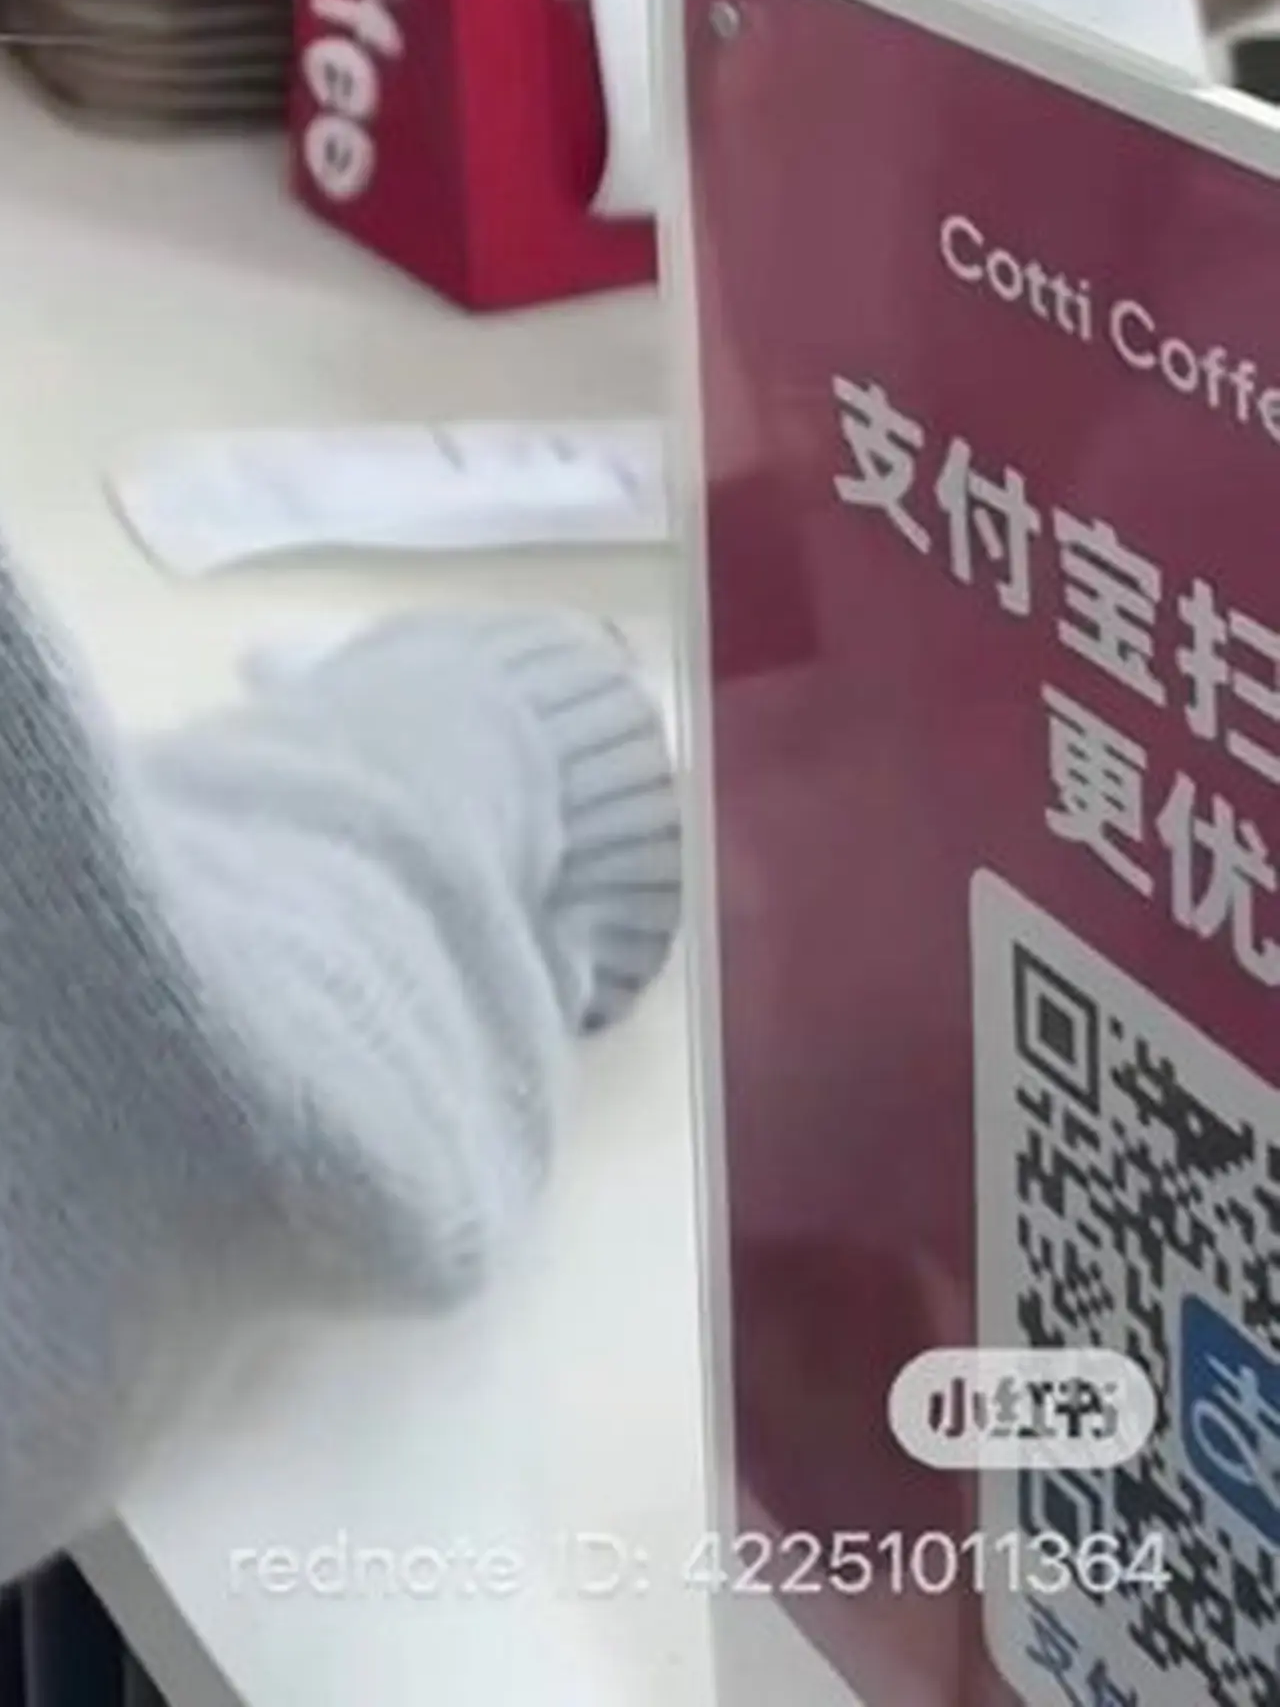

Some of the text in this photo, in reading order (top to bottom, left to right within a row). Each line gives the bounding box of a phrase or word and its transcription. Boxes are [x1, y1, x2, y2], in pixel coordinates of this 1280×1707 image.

[939, 215, 1093, 342] Cotti
[831, 373, 1280, 785] 支付宝扫
[1040, 683, 1280, 987] 更优
